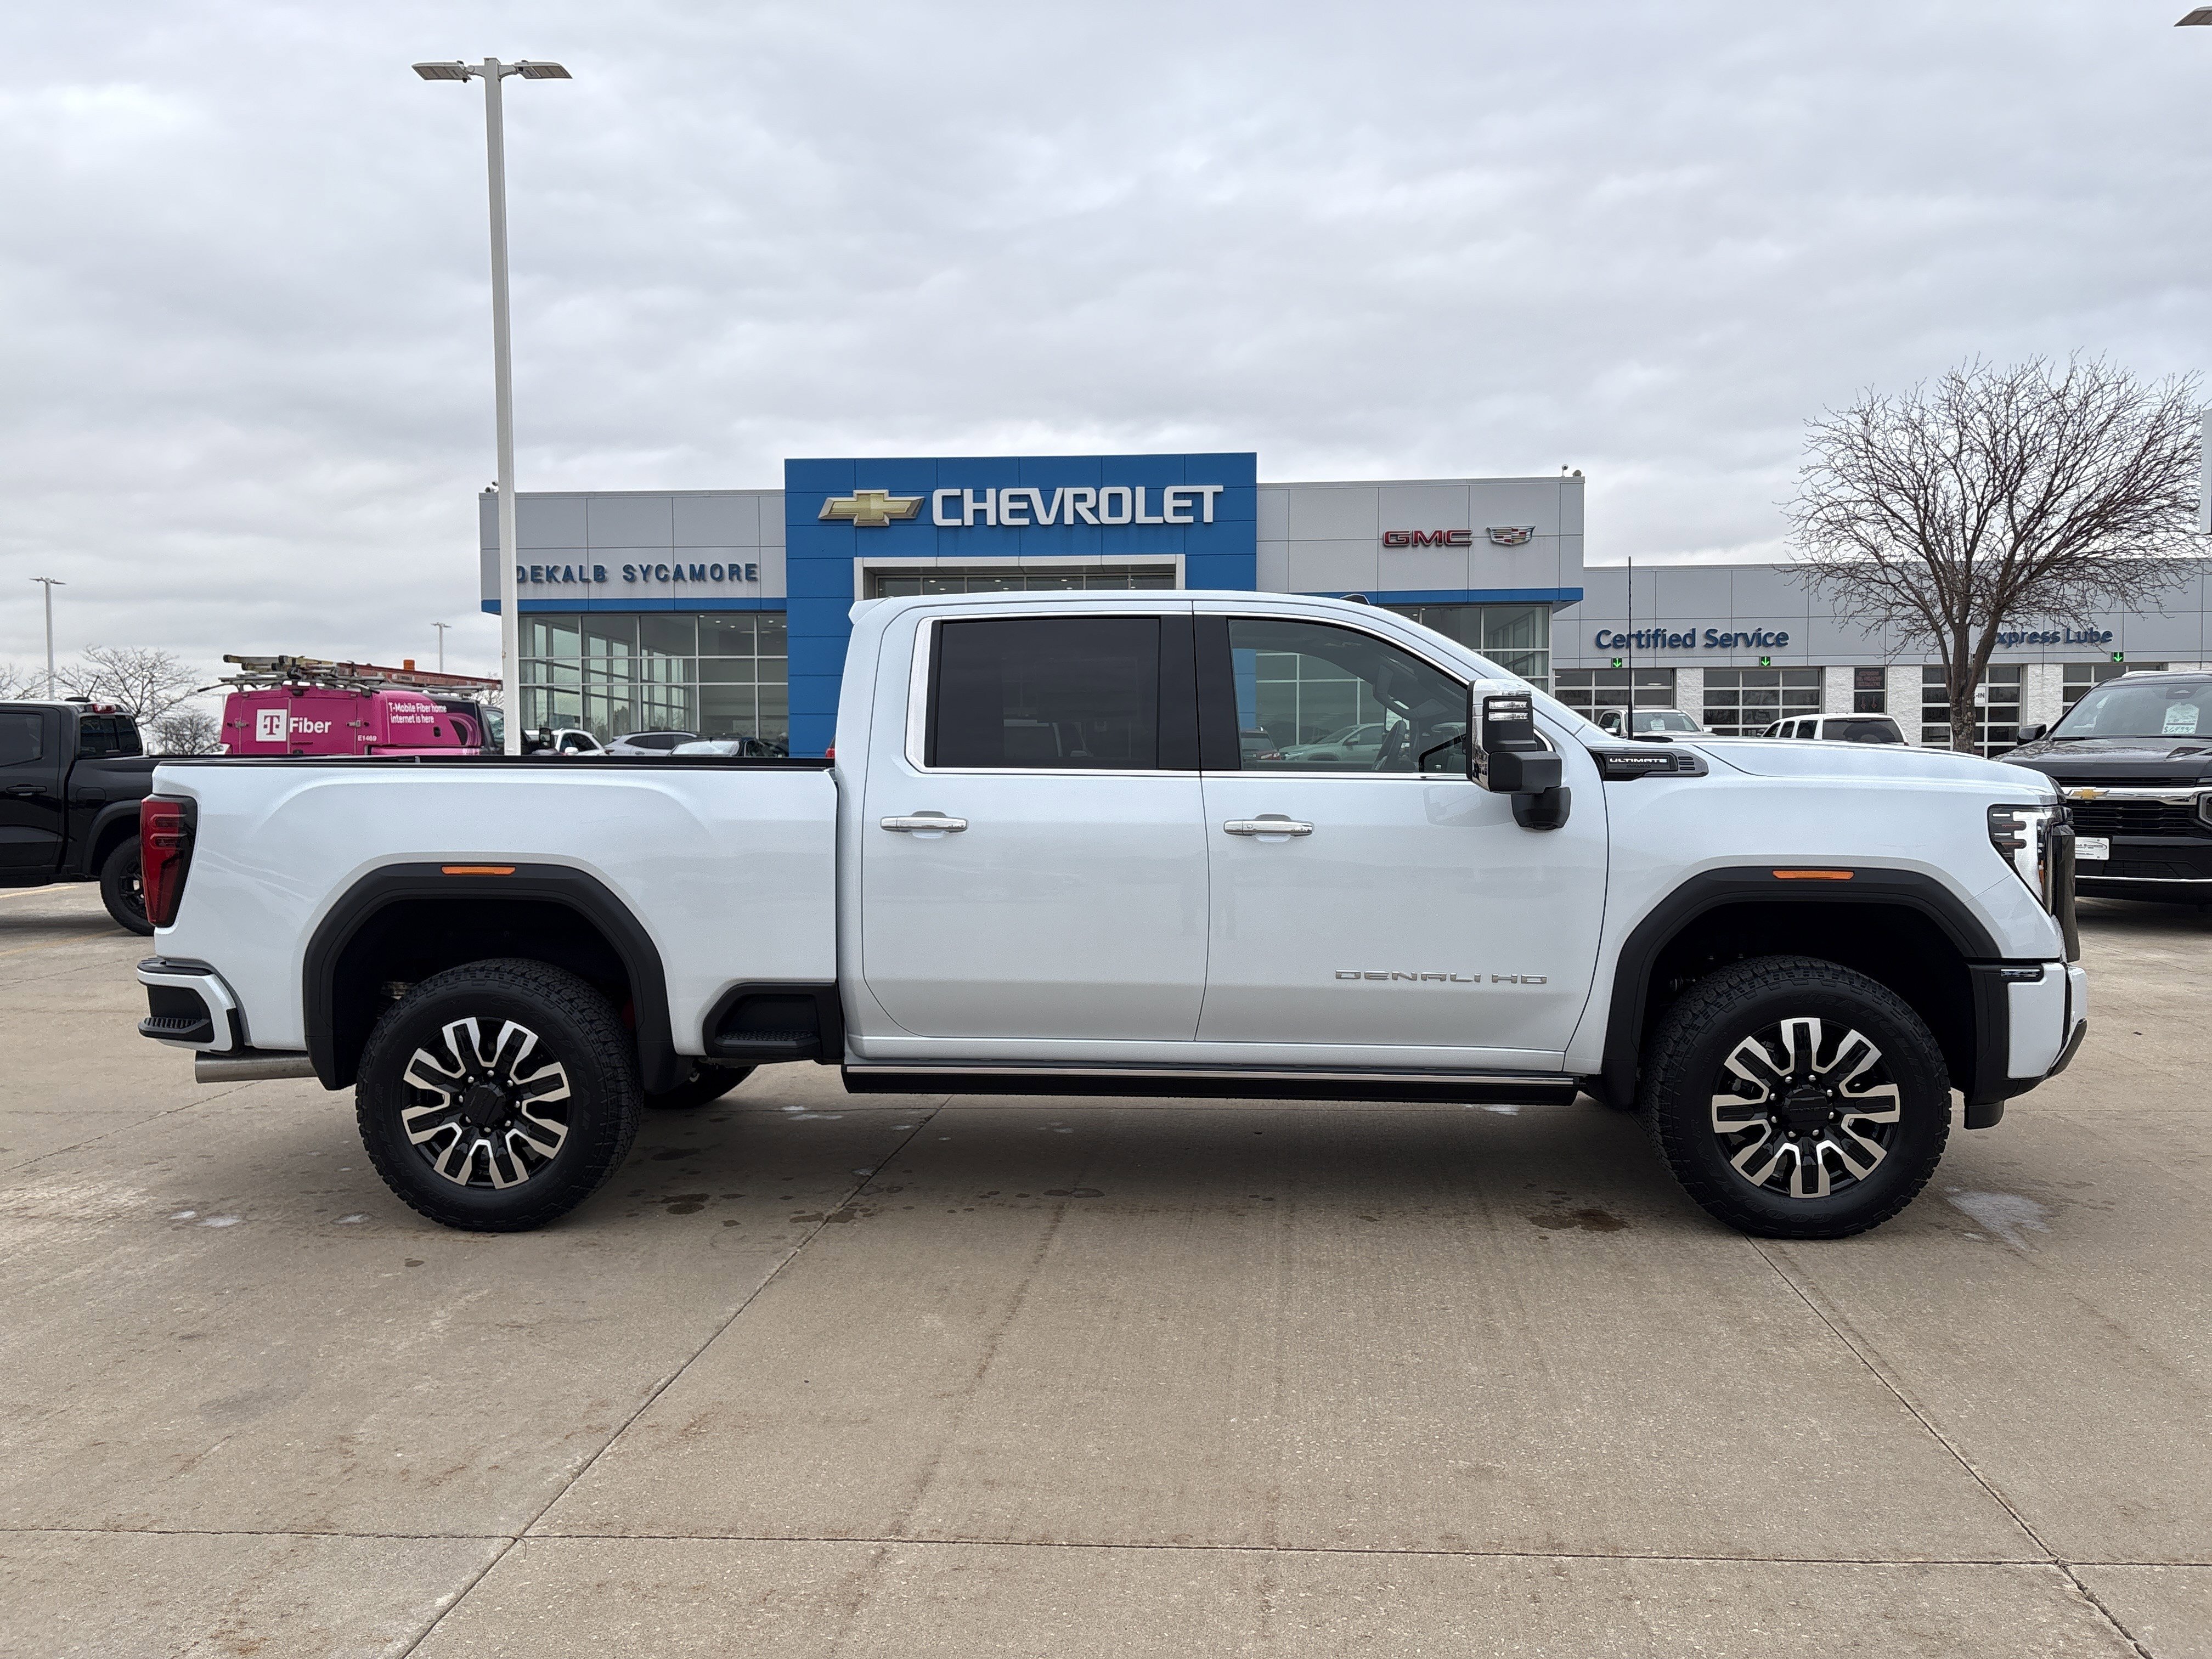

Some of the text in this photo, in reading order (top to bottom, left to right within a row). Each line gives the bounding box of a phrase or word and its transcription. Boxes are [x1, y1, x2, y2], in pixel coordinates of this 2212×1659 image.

[933, 485, 1223, 526] CHEVROLET
[1383, 529, 1472, 546] GMC
[516, 563, 758, 583] DEKALB SYCAMORE
[1595, 627, 1790, 649] Certified Service
[1996, 627, 2113, 648] xpress Lube
[388, 702, 447, 713] T-Mobile Fiber home
[289, 716, 332, 733] Fiber
[391, 714, 435, 724] internet is here
[1335, 969, 1548, 984] DENALI HD
[490, 995, 592, 1131] GOODYEAR
[1688, 1118, 1833, 1223] GOODYEAR
